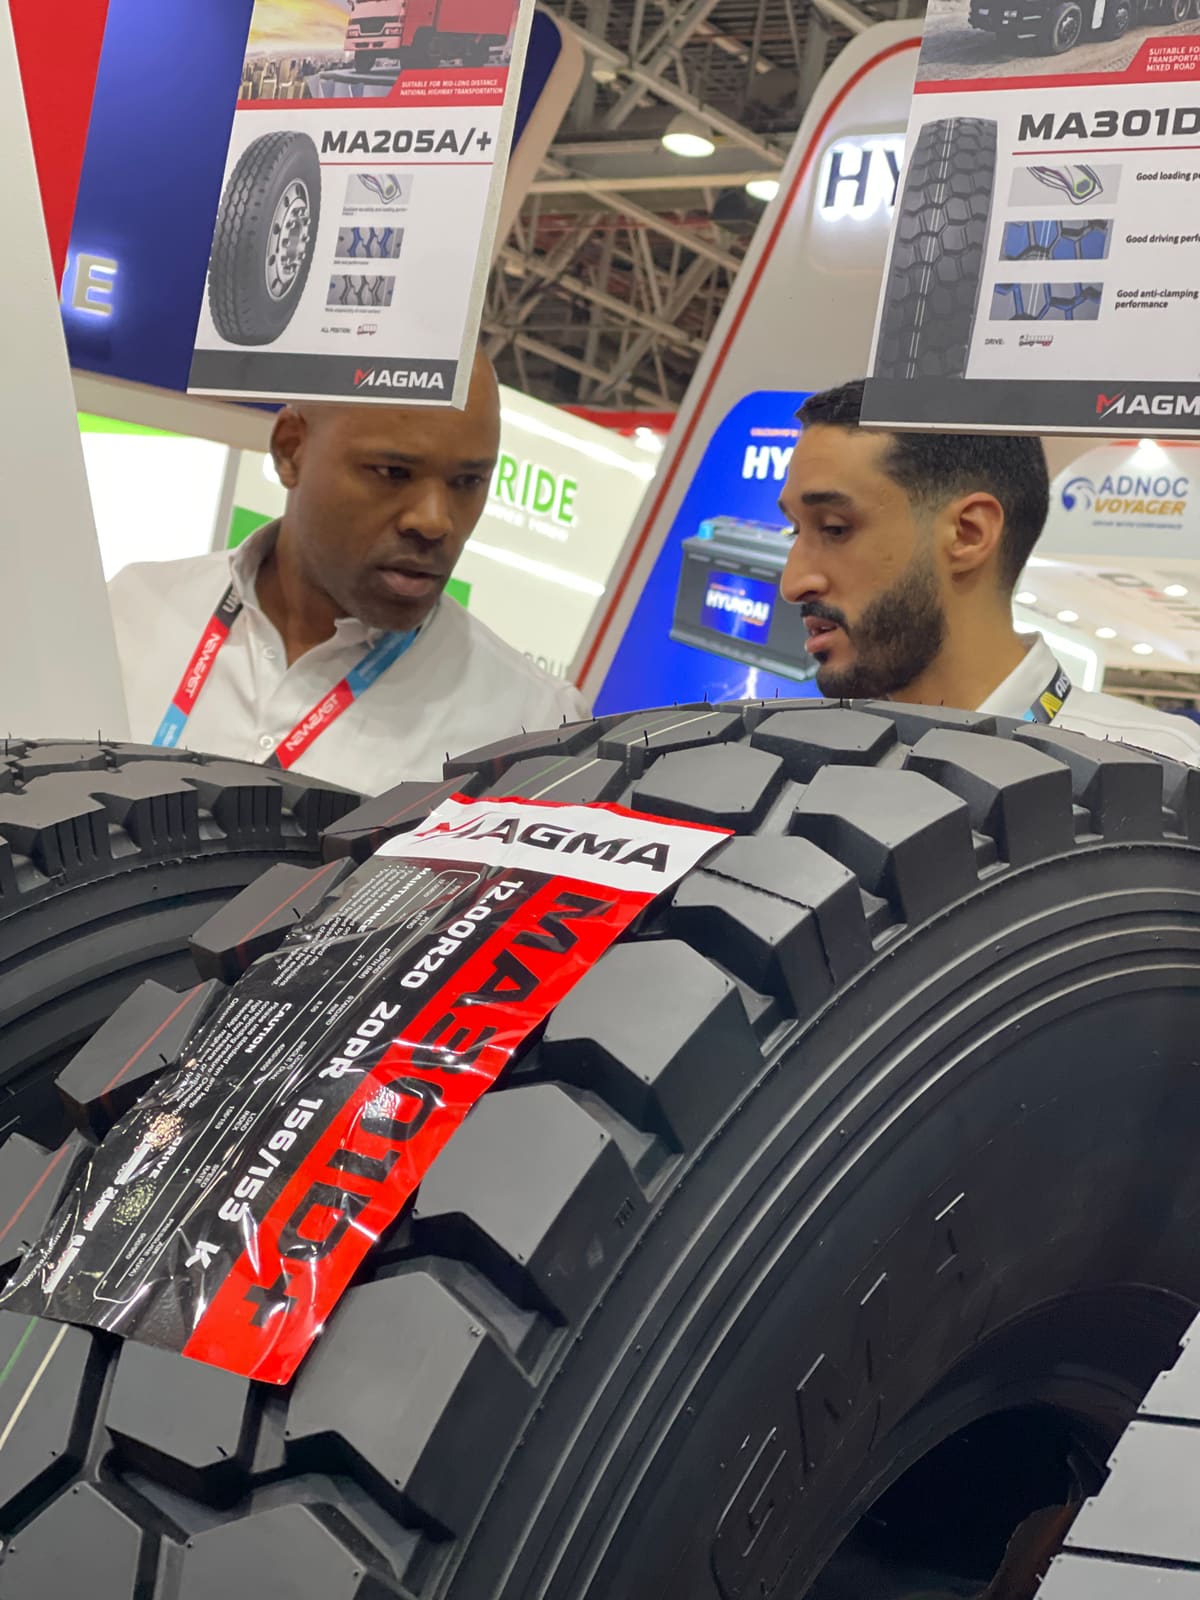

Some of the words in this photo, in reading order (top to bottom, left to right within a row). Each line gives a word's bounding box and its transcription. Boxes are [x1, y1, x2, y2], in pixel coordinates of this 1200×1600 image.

[1149, 47, 1186, 55] SUITABLE
[1146, 64, 1170, 72] MIXED
[1174, 63, 1195, 71] ROAD
[400, 88, 426, 96] NATIONAL
[453, 87, 503, 95] TRANSPORTATION
[402, 80, 427, 88] SUITABLE
[1018, 107, 1200, 141] MA301D
[321, 127, 492, 156] MA205A/+
[1136, 172, 1158, 181] Good
[1160, 172, 1191, 181] loading
[1126, 234, 1148, 243] Good
[1149, 234, 1179, 244] driving
[1116, 289, 1139, 298] Good
[1140, 289, 1199, 299] anti-clamping
[1115, 301, 1168, 310] performance
[353, 367, 444, 390] MAGMA
[742, 445, 794, 480] HY
[1098, 475, 1189, 498] ADNOC
[1094, 497, 1186, 516] VOYAGER
[706, 589, 770, 621] HYUNDAI
[408, 812, 670, 873] MAGMA
[355, 867, 431, 933] MAINTENANCE
[397, 879, 524, 988] 12.00R20
[370, 948, 391, 965] DEPTH
[246, 999, 263, 1013] high
[256, 1001, 280, 1023] Please
[324, 995, 354, 1025] STANDARD
[325, 1003, 339, 1014] RIM
[228, 1000, 271, 1044] corresponding
[229, 1021, 244, 1033] low
[240, 1013, 250, 1021] or
[243, 1002, 293, 1053] CAUTION
[245, 1023, 260, 1035] use
[316, 1000, 402, 1079] 20PR
[221, 1035, 249, 1064] standard
[285, 1040, 307, 1061] SINGLE
[198, 1063, 207, 1071] or
[211, 1064, 226, 1076] rim
[202, 1077, 216, 1091] and
[186, 1092, 207, 1109] keep
[231, 1110, 250, 1131] INDEX
[238, 1112, 257, 1131] LOAD
[147, 1136, 183, 1178] DRIVE
[213, 1099, 323, 1222] 156/153
[193, 1165, 211, 1183] RATE
[198, 1164, 220, 1187] SPEED
[141, 1218, 174, 1256] PRESSURE
[183, 1239, 220, 1268] K
